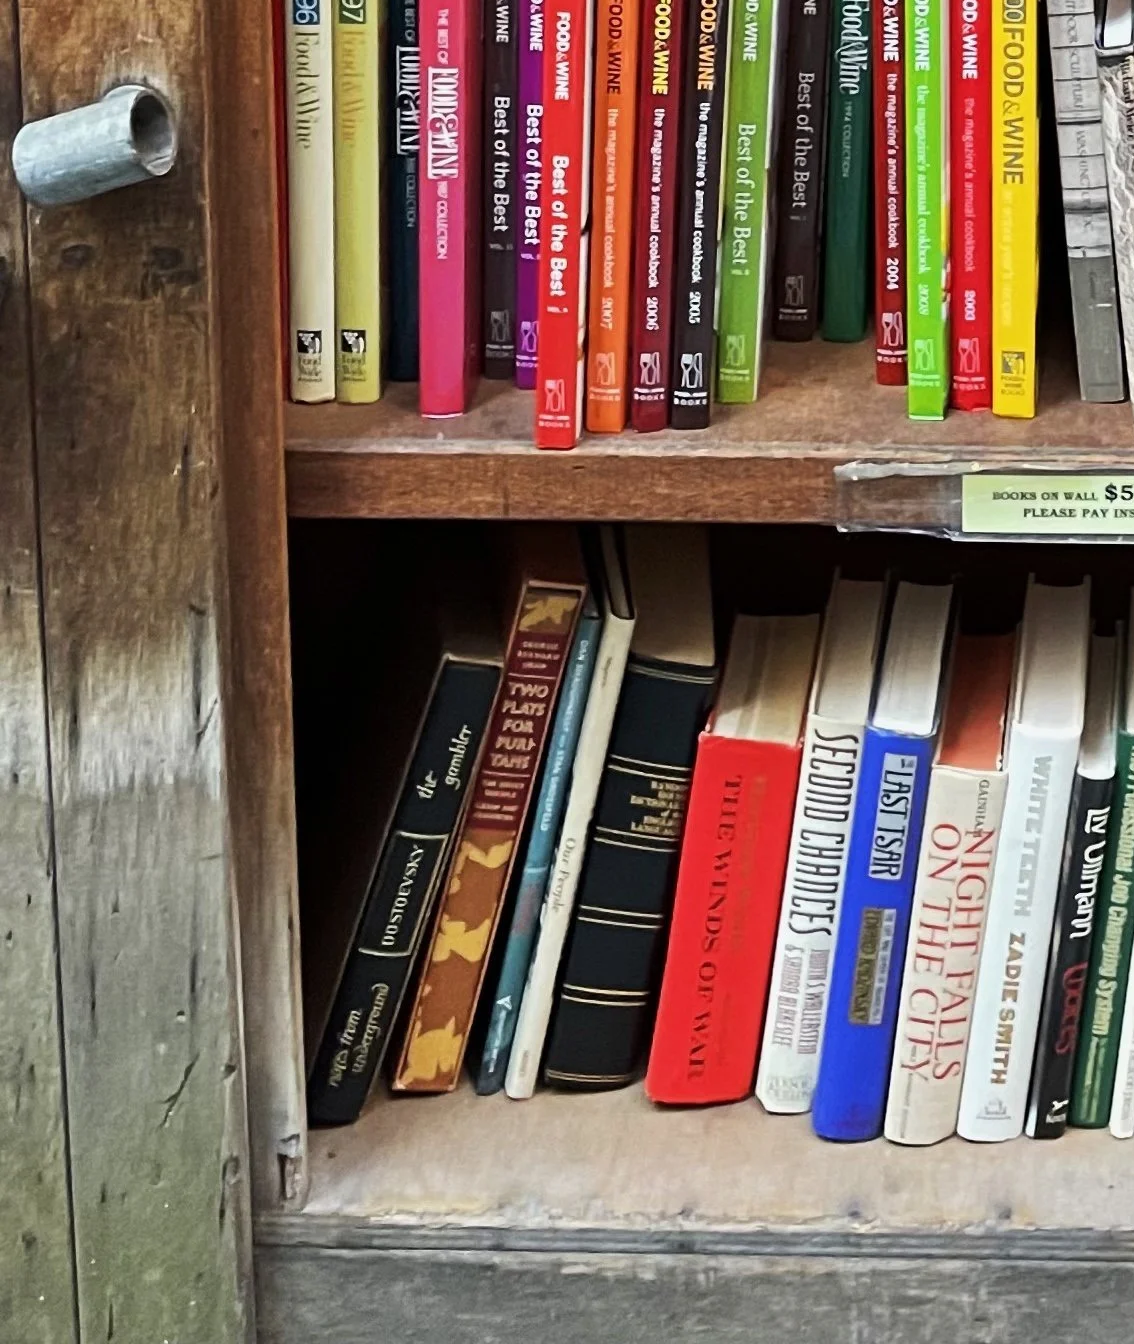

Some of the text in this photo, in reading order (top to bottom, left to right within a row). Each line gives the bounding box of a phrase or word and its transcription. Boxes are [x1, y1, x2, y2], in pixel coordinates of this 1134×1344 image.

[886, 73, 898, 90] the
[884, 94, 899, 154] magazine's
[887, 158, 899, 194] annual
[547, 155, 569, 296] Best of the Best
[886, 199, 901, 248] cookbook
[885, 258, 899, 290] 2004
[993, 492, 1037, 500] BOOKS
[1041, 492, 1058, 500] ON
[1064, 492, 1098, 501] WALL
[1105, 483, 1134, 502] $5
[1023, 508, 1077, 519] PLEASE
[1082, 508, 1108, 519] PAY
[687, 775, 743, 1080] THE WINDS OF WAR
[900, 824, 960, 1081] ON THE CITY
[931, 828, 996, 1079] NIGHT FALLS
[990, 932, 1026, 1085] ZADIE SMITH
